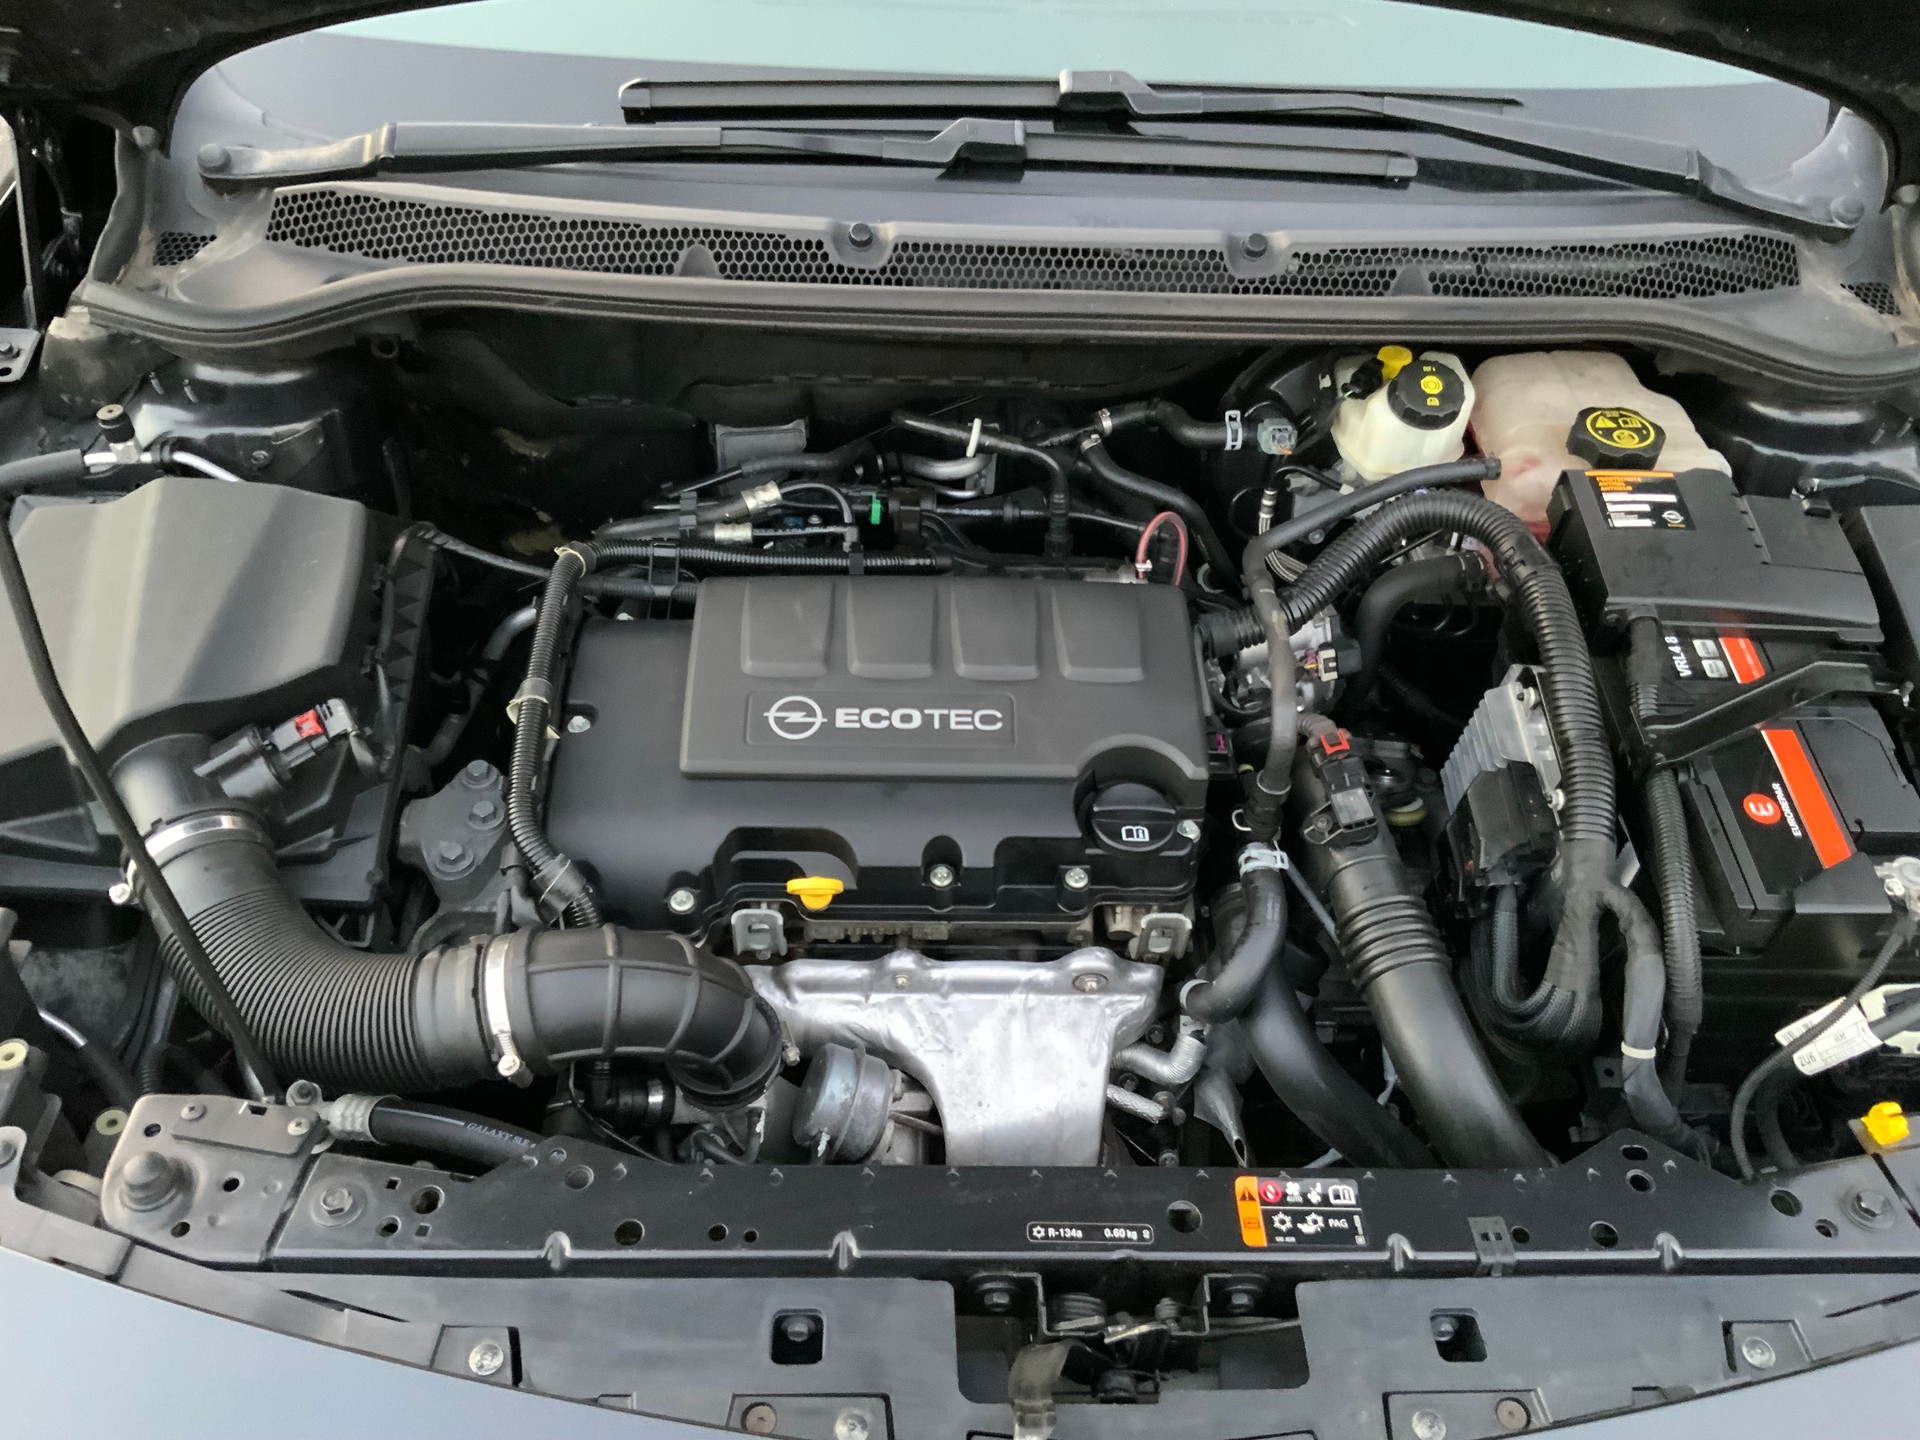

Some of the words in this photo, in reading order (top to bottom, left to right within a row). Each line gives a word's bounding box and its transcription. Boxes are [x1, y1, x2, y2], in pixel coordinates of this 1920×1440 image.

[835, 707, 1004, 732] ECOTEC
[1771, 782, 1803, 838] EUROREPAR
[1798, 1052, 1816, 1067] 2U6
[466, 1122, 513, 1141] GALAXY
[1328, 1218, 1349, 1229] PAG
[1047, 1227, 1083, 1239] R-134a
[1103, 1227, 1126, 1239] 0.60
[1126, 1229, 1138, 1241] kg
